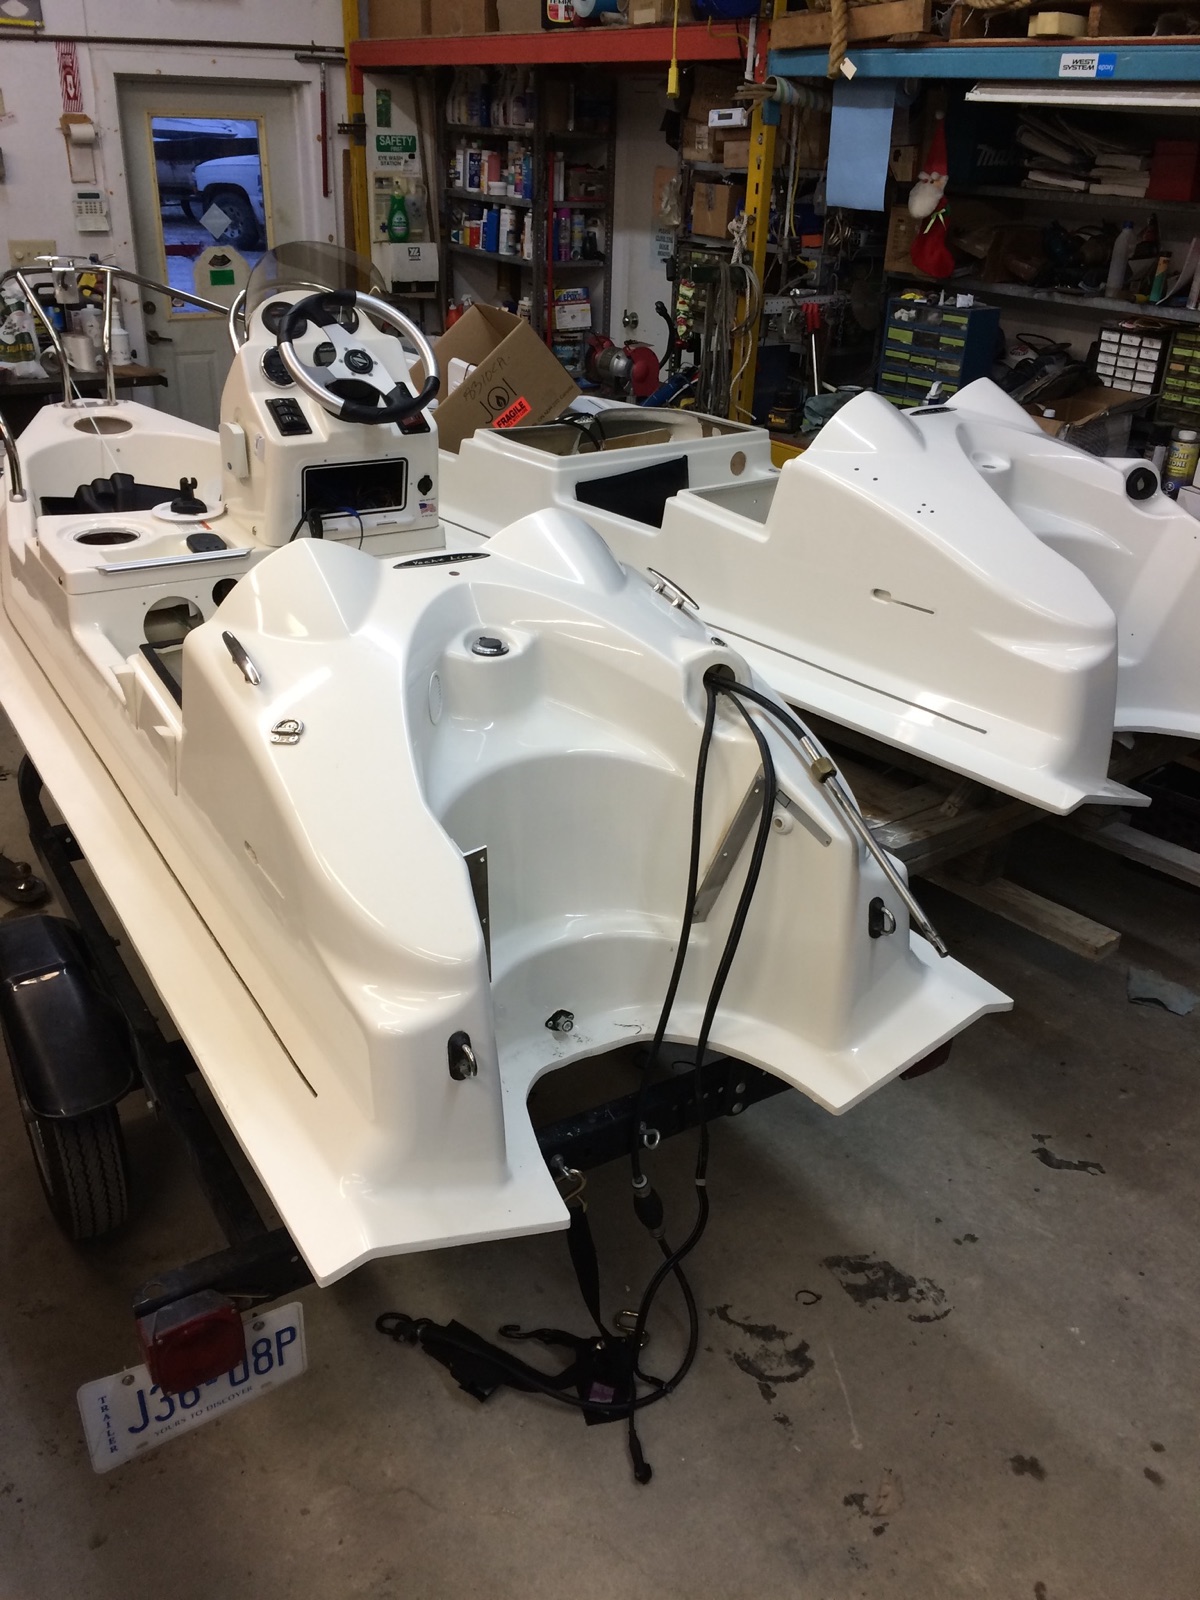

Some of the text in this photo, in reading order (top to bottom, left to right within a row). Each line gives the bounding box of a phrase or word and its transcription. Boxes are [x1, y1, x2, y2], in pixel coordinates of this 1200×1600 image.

[379, 136, 413, 146] SAFETY
[497, 401, 526, 428] FRAGILE
[98, 1395, 118, 1454] TRAILER
[154, 1385, 254, 1437] YOURS TO DISCOVER
